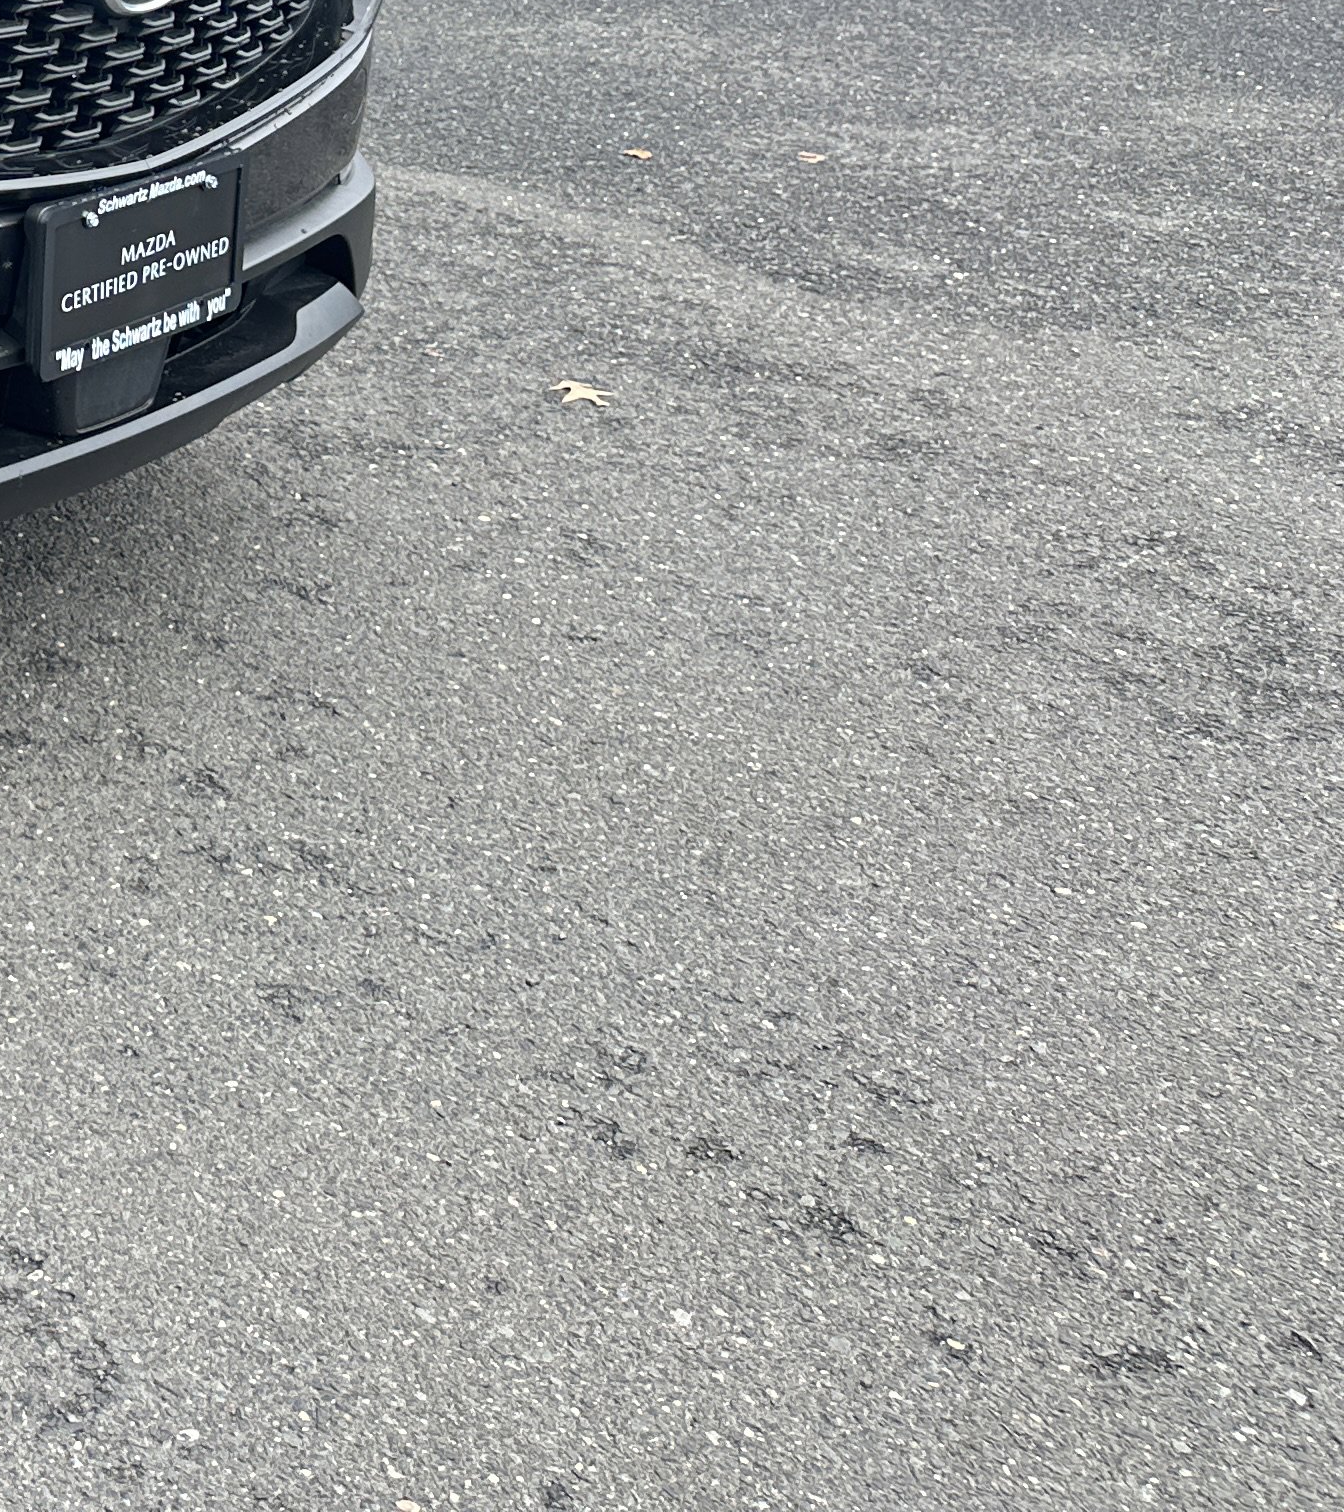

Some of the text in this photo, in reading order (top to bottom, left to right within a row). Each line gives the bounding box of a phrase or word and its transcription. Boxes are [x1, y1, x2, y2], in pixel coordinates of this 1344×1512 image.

[97, 188, 149, 215] Schwartz
[61, 236, 230, 313] CERTIFIED PRE-OWNED
[121, 229, 176, 266] MAZDA
[55, 287, 232, 372] "May the Schwartz be with you"
